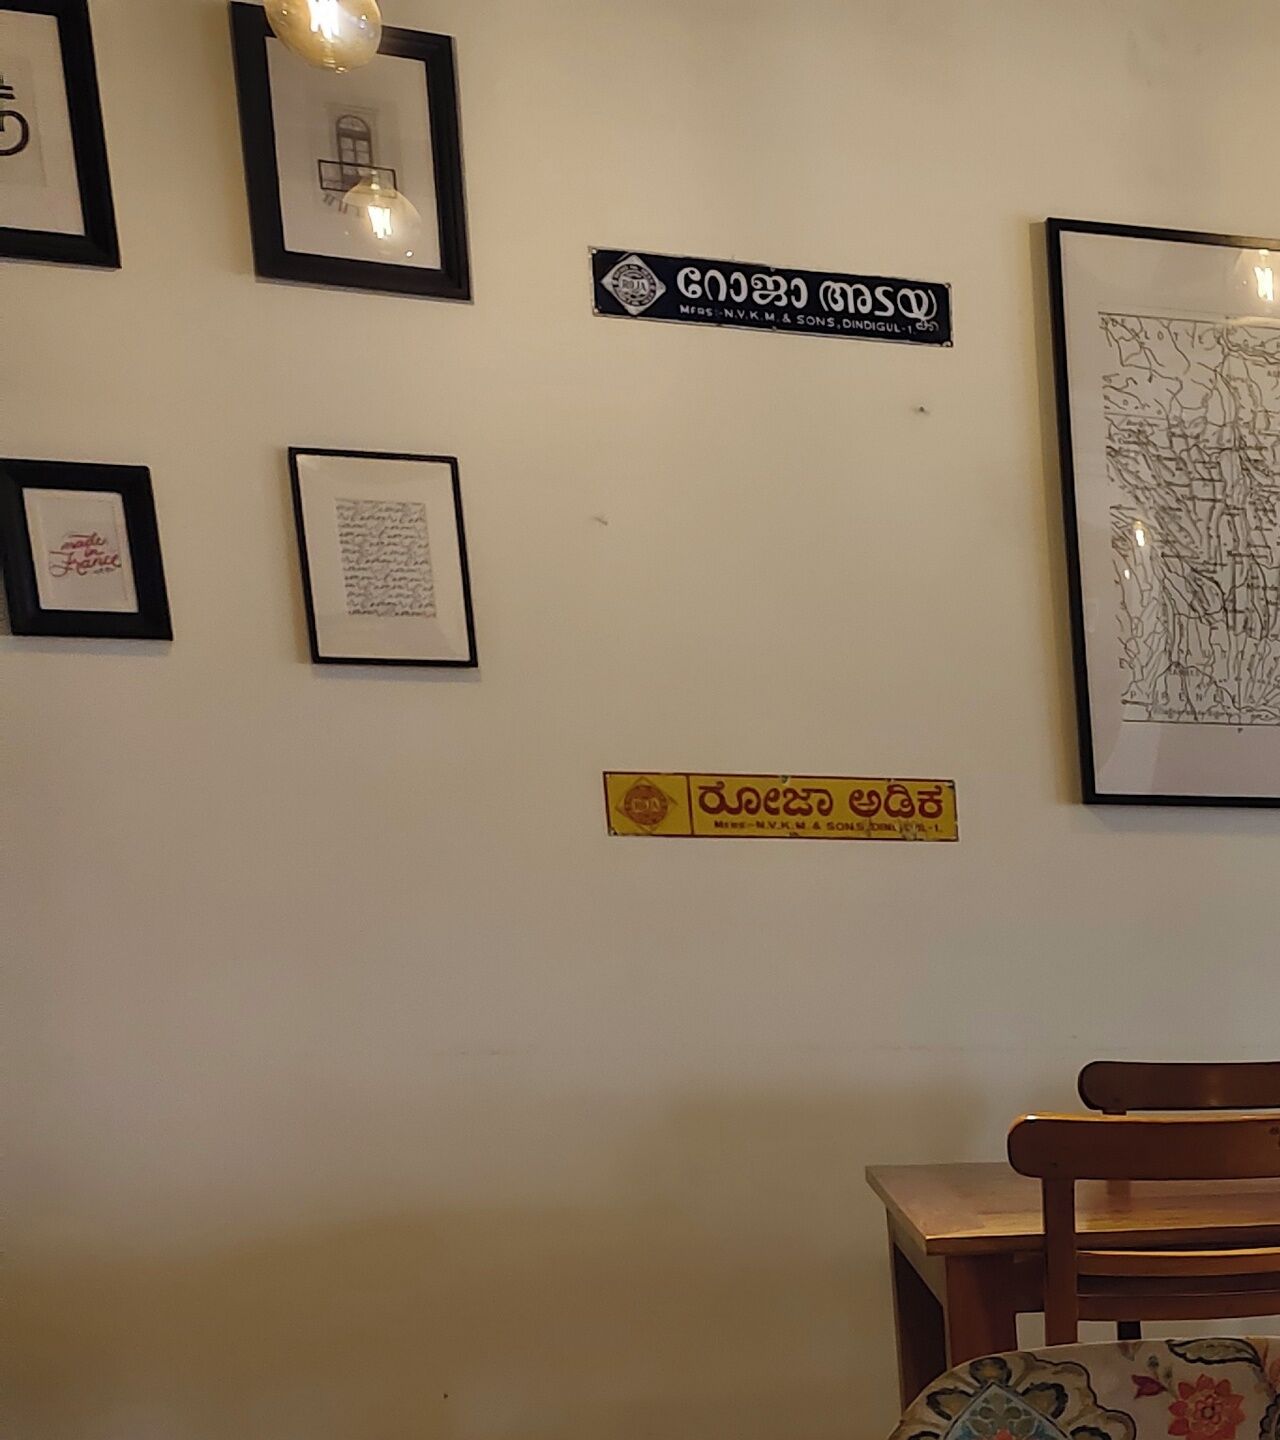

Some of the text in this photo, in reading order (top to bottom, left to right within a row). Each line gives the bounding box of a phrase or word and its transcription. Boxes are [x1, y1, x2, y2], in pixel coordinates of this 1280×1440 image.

[677, 267, 808, 308] റോജാ
[781, 313, 792, 323] &
[698, 780, 833, 816] ರೋಜಾ
